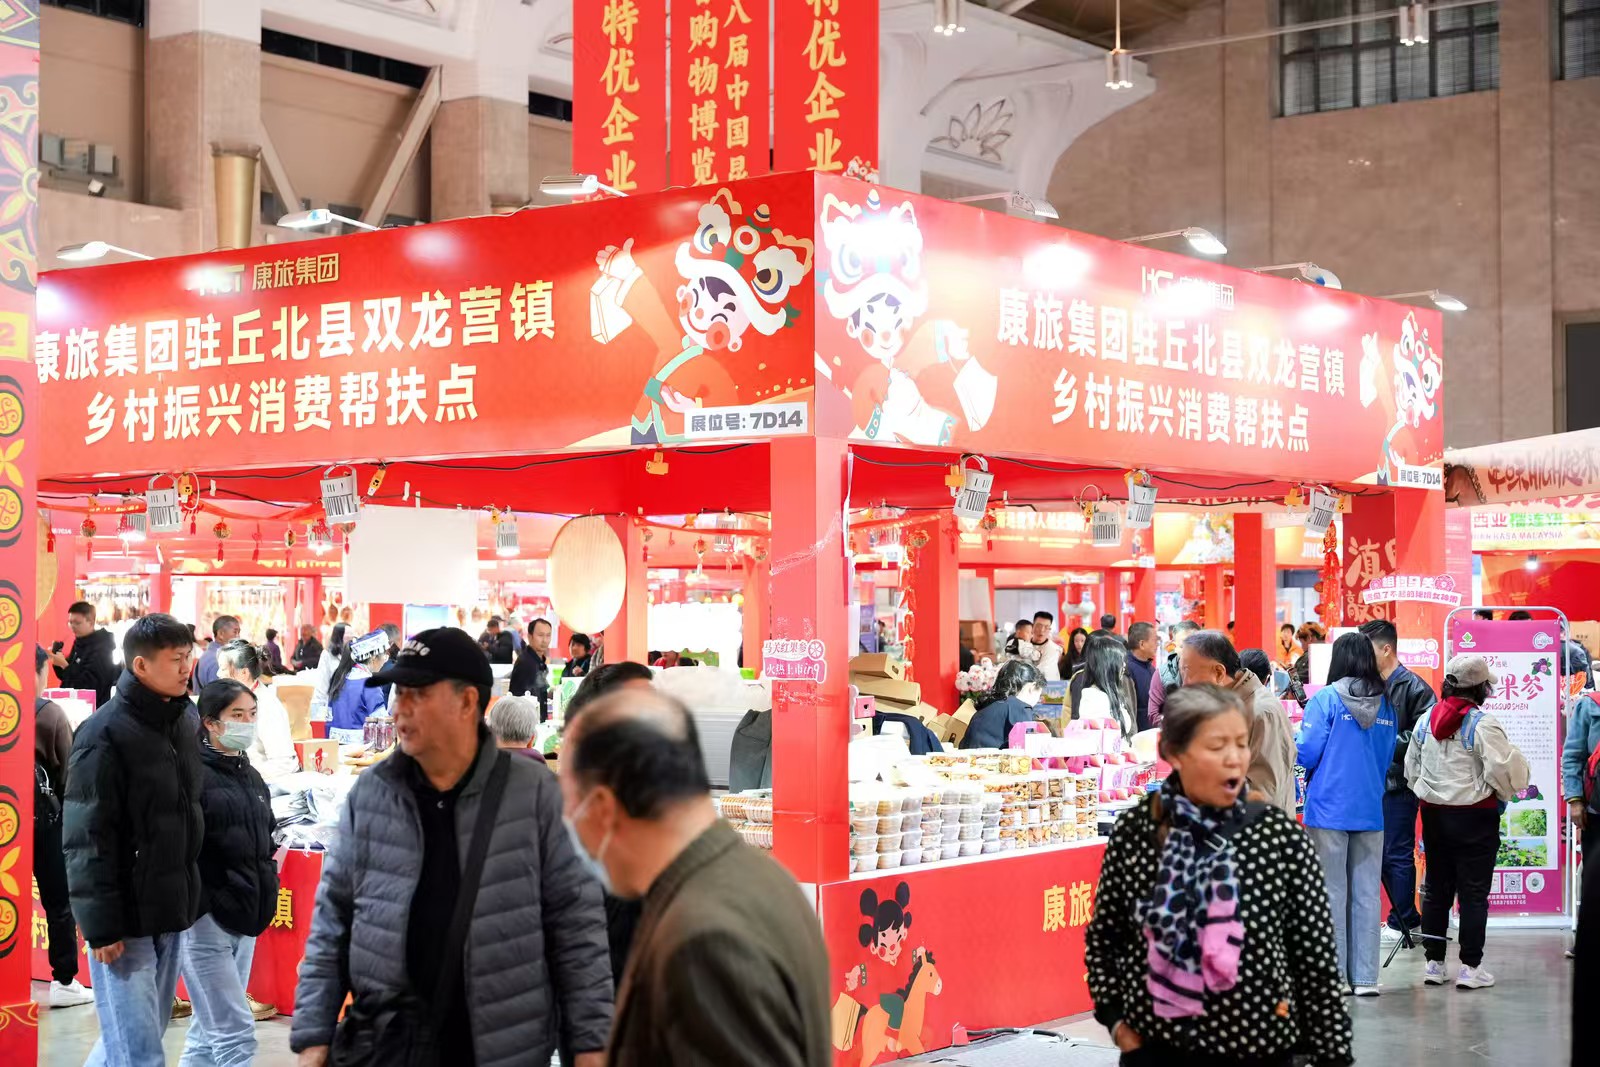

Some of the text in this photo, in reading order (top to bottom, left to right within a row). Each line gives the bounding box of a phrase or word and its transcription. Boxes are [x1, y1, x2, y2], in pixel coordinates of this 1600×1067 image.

[688, 0, 719, 187] 购物博览
[252, 253, 339, 290] 康旅集团
[35, 280, 555, 384] 康旅集团驻丘北县双龙营镇
[997, 288, 1345, 398] 康旅集团驻丘北县双龙营镇
[85, 363, 478, 445] 乡村振兴消费帮扶点
[1052, 369, 1309, 452] 乡村振兴消费帮扶点
[765, 641, 807, 654] 马关红果参
